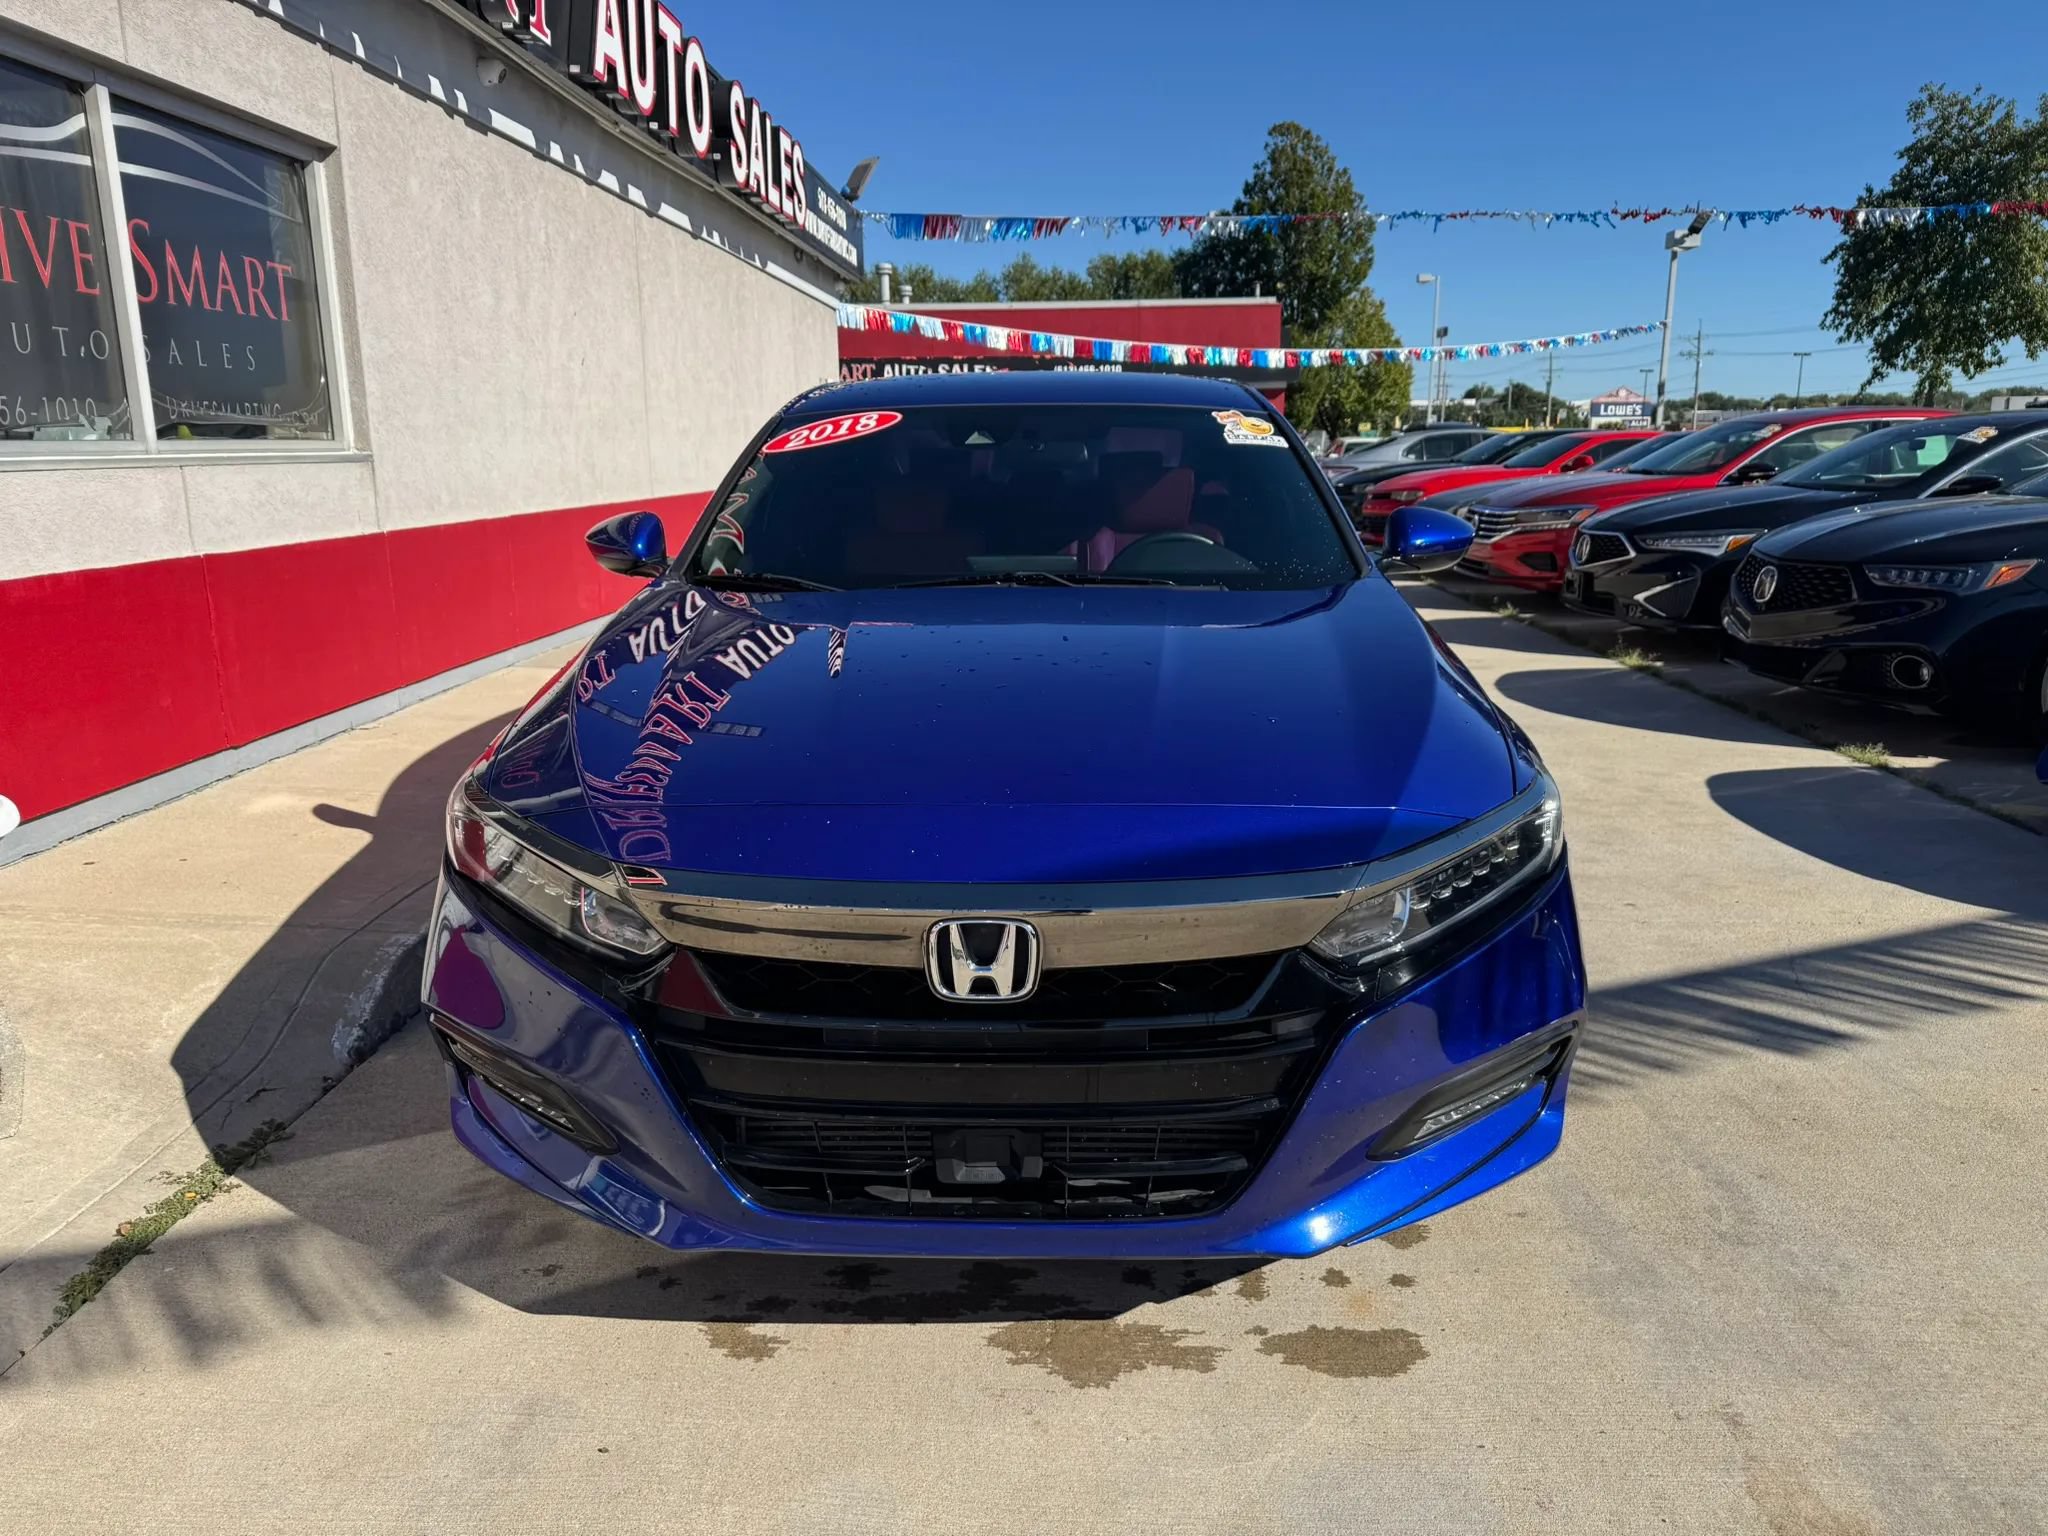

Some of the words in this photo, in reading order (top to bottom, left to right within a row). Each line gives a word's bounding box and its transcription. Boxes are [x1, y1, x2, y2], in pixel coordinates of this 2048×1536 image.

[593, 0, 710, 159] AUTO
[729, 80, 806, 229] SALES
[127, 218, 294, 322] SMART
[784, 413, 880, 449] 2018
[1600, 403, 1643, 416] LOWE'S
